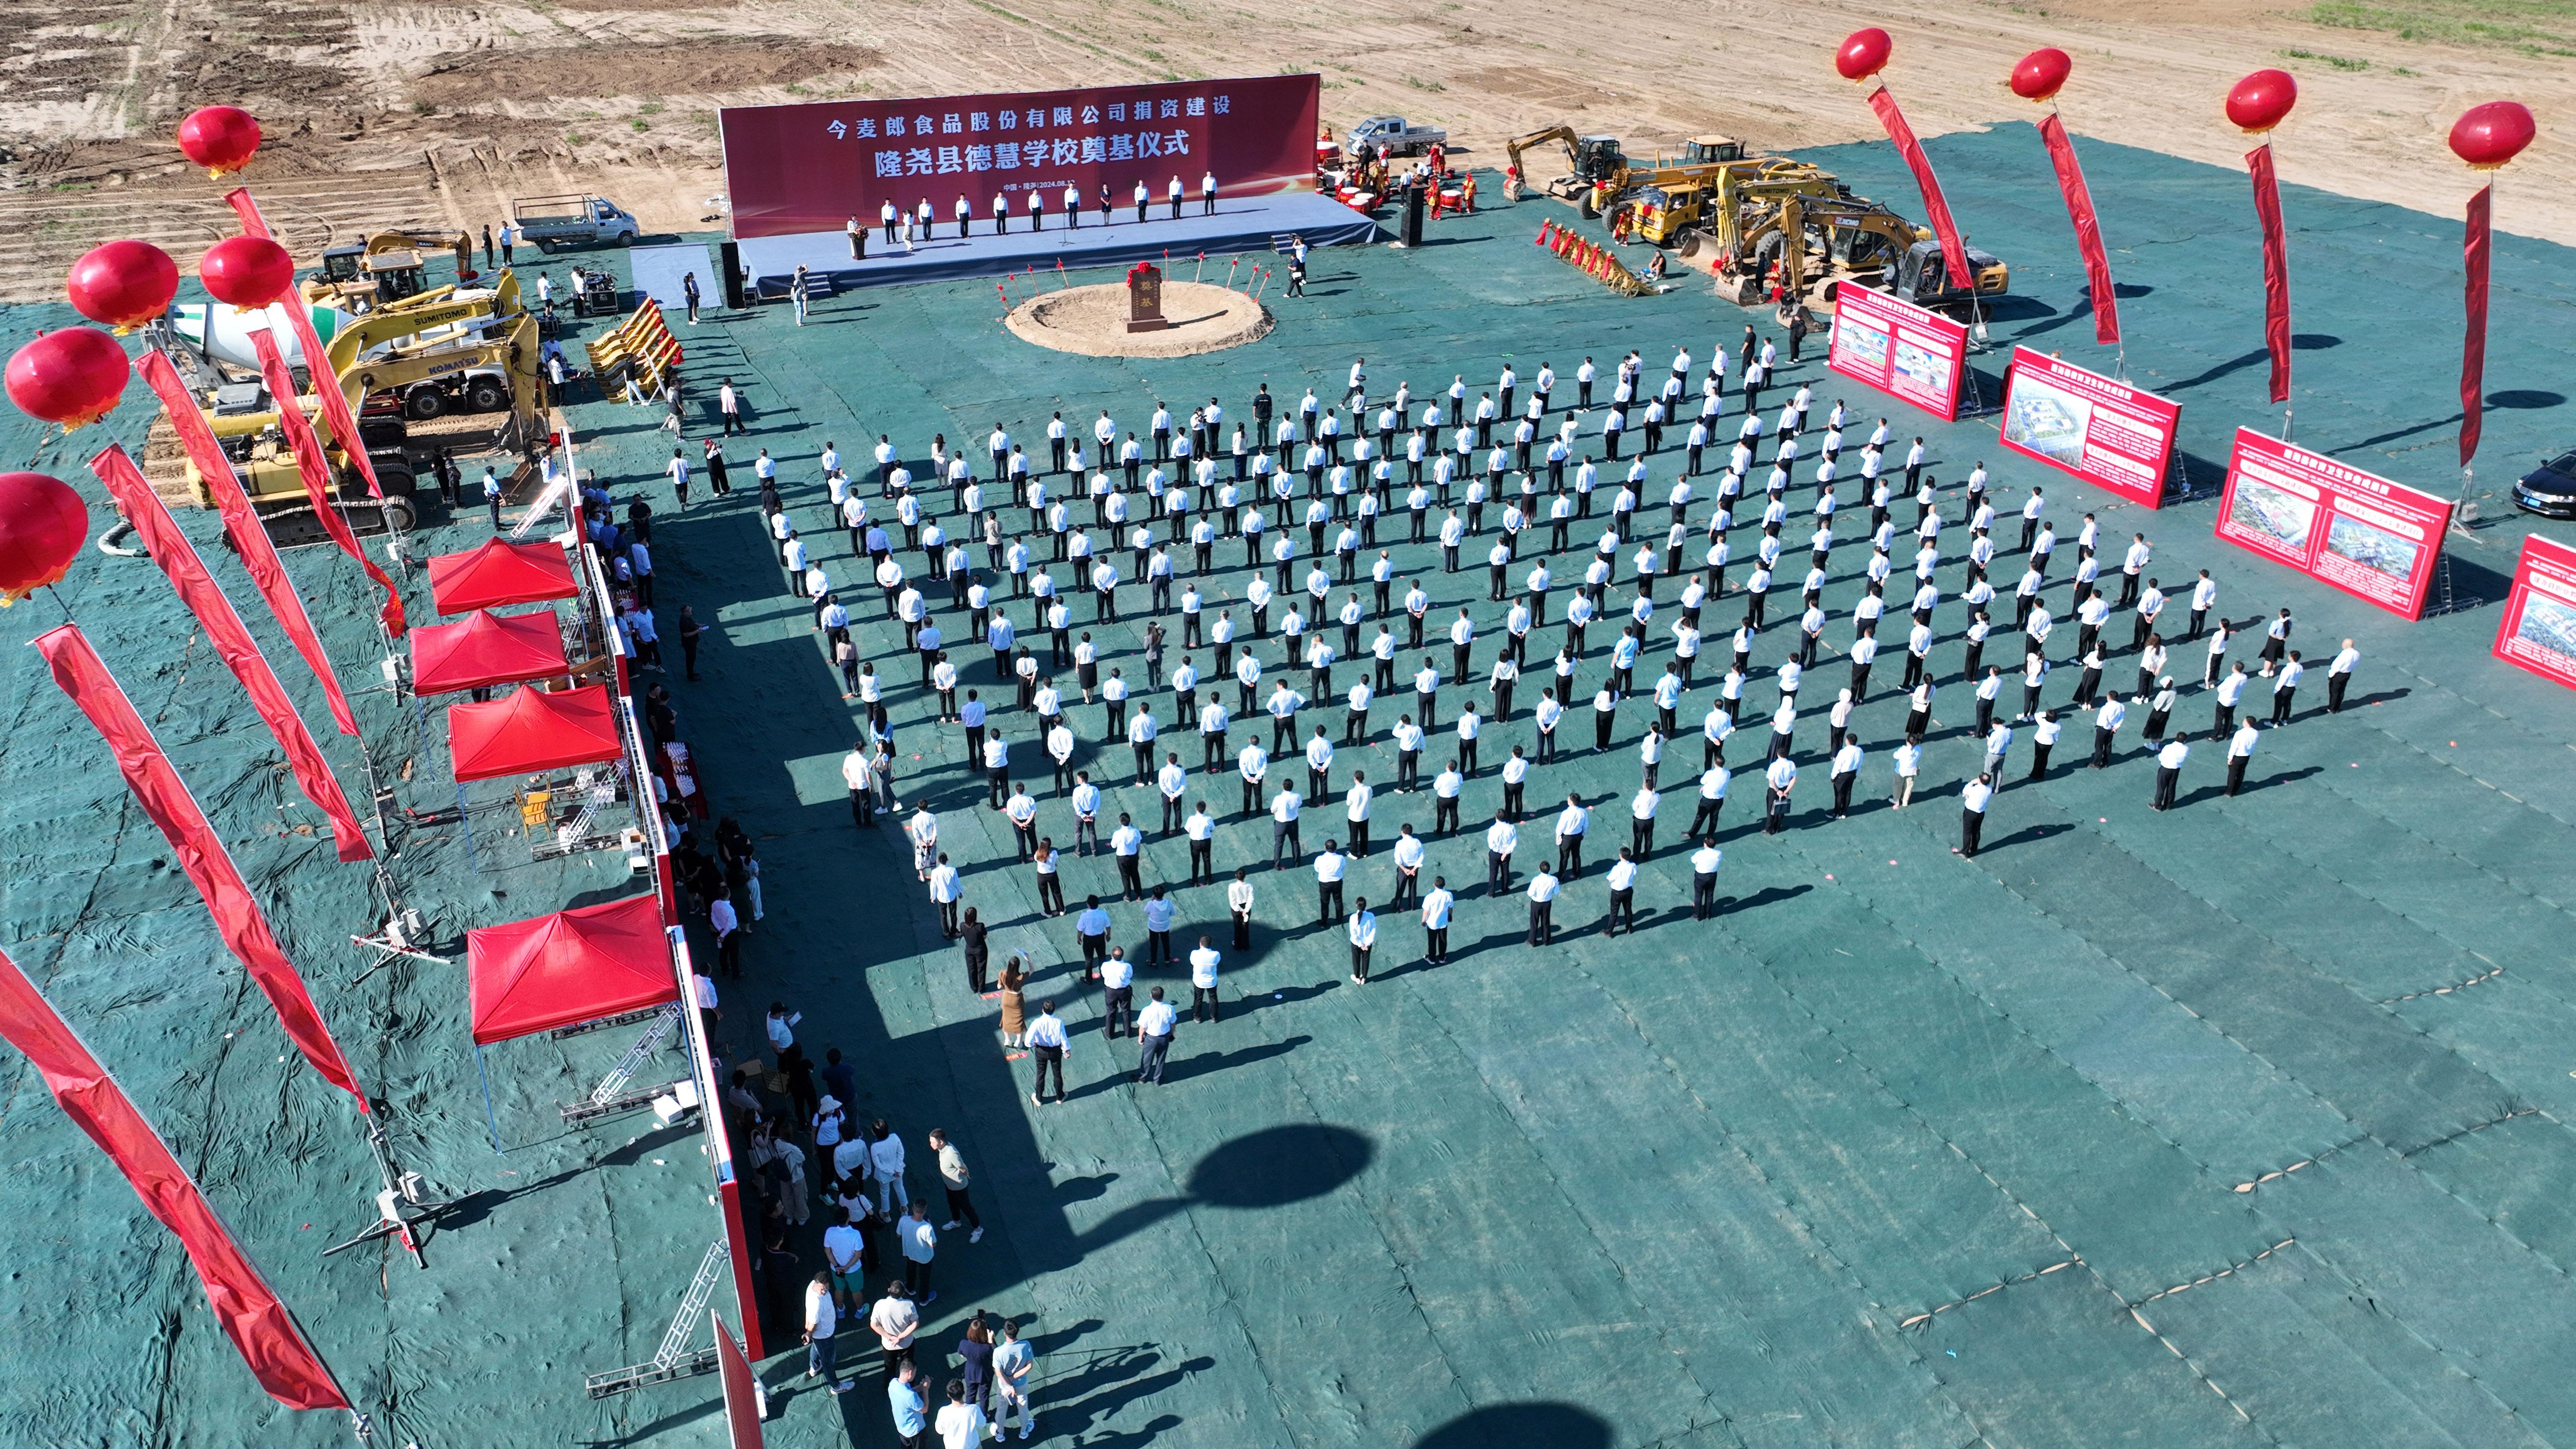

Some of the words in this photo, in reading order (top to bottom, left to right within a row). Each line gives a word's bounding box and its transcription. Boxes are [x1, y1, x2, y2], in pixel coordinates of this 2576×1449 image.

[826, 95, 1230, 140] 今麦郎食品股份有限公司捐资建设
[875, 129, 1190, 178] 隆尧县德慧学校奠基仪式
[414, 309, 467, 325] SUMITOMO
[428, 357, 479, 374] KOMATSU
